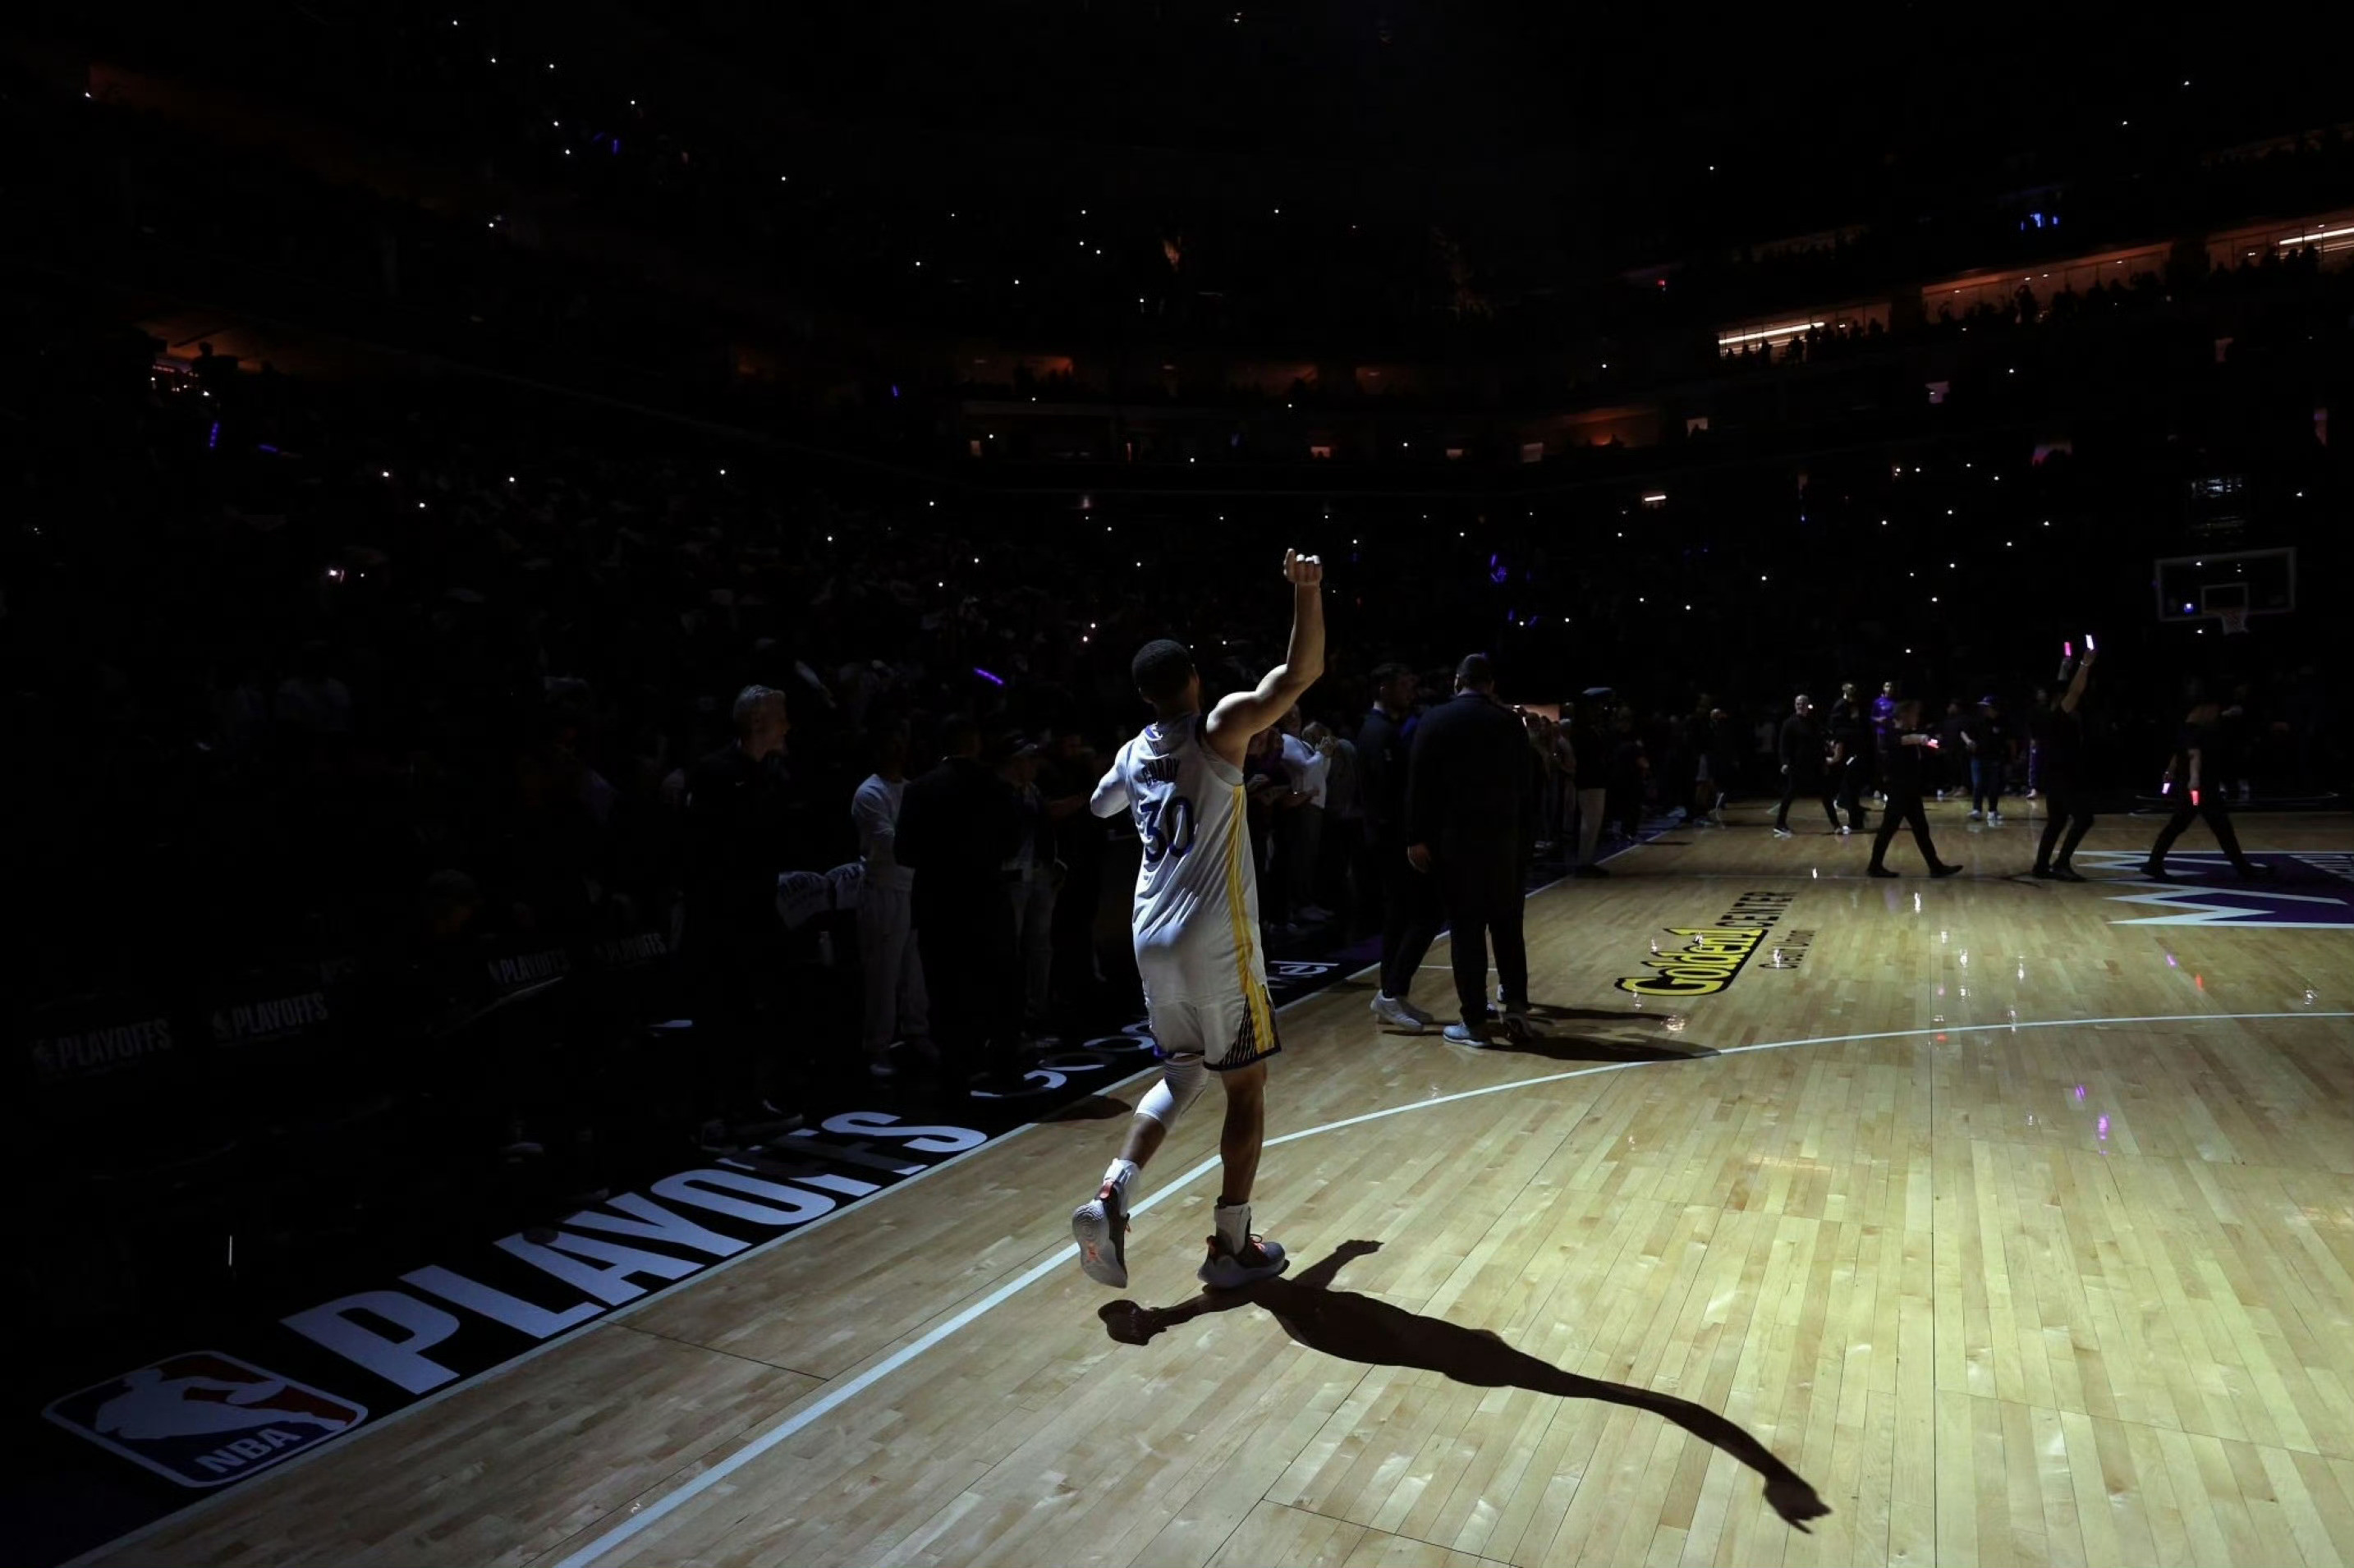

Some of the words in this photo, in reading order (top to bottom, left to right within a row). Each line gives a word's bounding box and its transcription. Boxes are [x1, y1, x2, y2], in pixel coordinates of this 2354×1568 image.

[1139, 796, 1195, 864] 30
[1715, 892, 1798, 928] CENTER
[232, 992, 328, 1034] PLAYOFFS
[57, 1018, 172, 1068] PLAYOFFS
[195, 1428, 302, 1473] NBA
